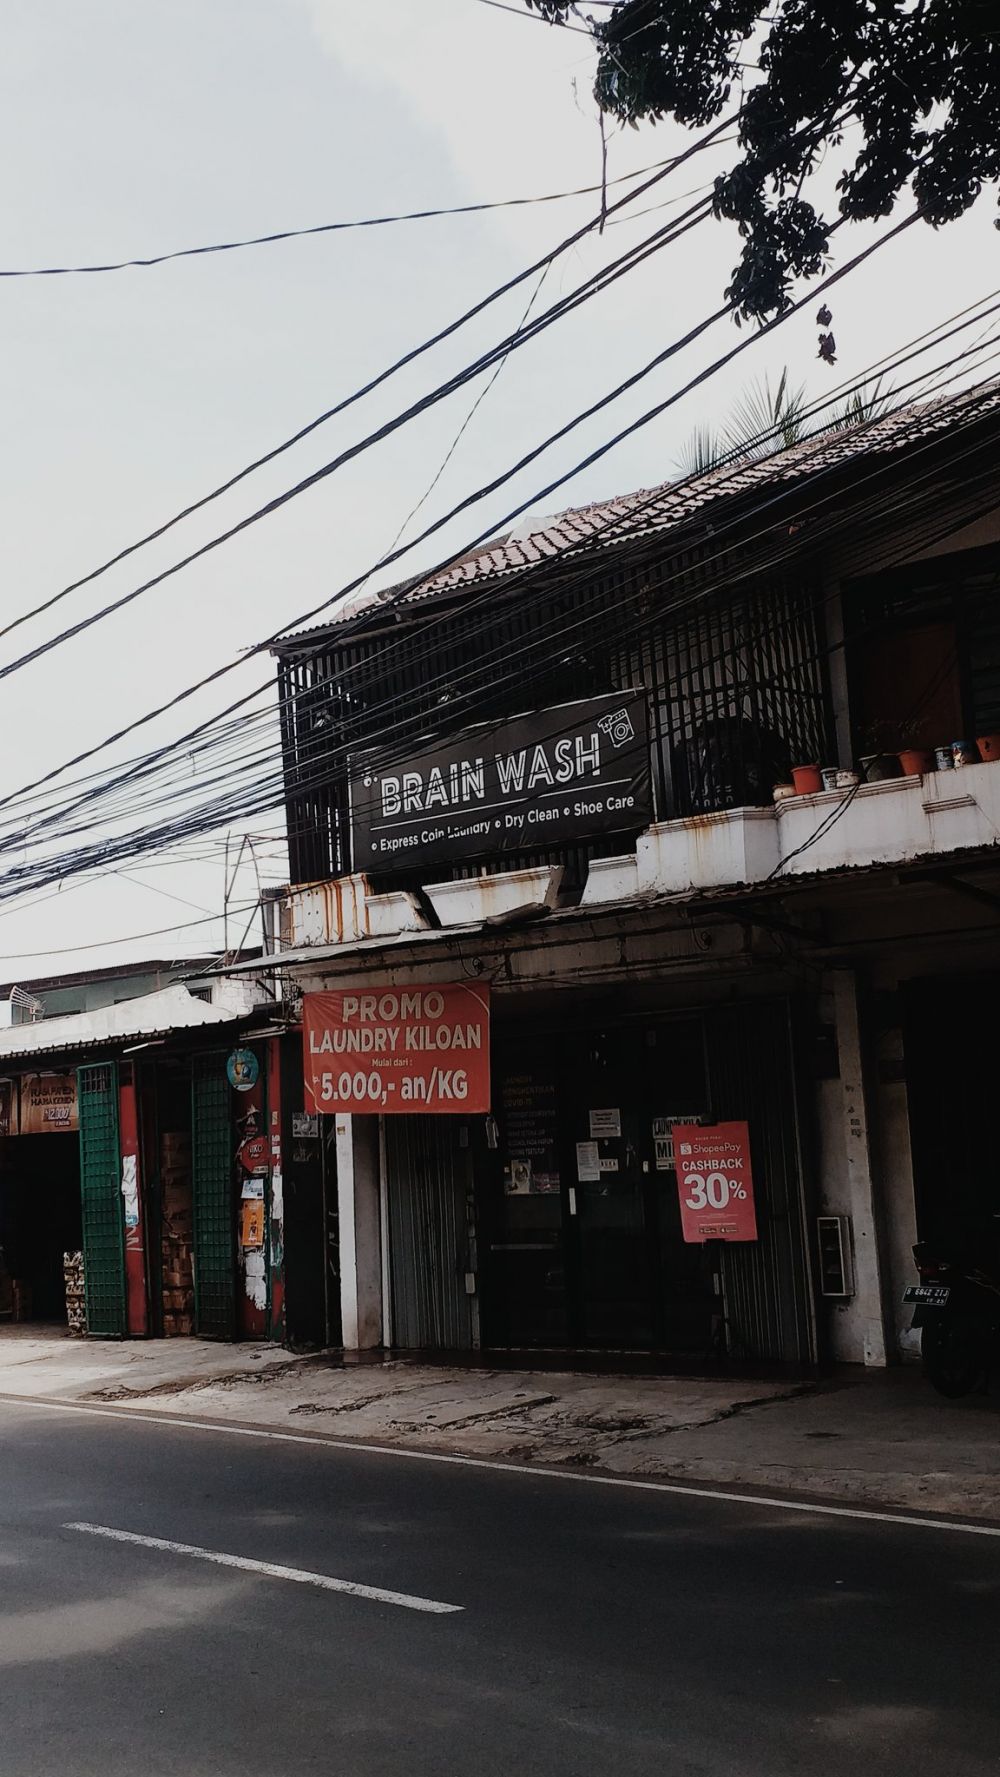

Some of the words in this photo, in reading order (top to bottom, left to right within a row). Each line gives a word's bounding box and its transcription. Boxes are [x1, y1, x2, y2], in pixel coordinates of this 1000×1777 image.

[381, 757, 485, 817] BRAIN
[495, 733, 601, 794] WASH
[380, 835, 419, 852] Express
[421, 829, 445, 843] Coin
[505, 813, 525, 830] Dry
[527, 806, 560, 824] Clean
[574, 801, 603, 816] Shoe
[606, 795, 635, 810] Care
[342, 991, 444, 1023] PROMO
[309, 1026, 400, 1054] LAUNDRY
[405, 1023, 481, 1051] KILOAN
[371, 1058, 391, 1067] Mulai
[400, 1067, 468, 1104] an/KG
[682, 1158, 743, 1171] CASHBACK
[693, 1142, 742, 1155] ShopeePay
[684, 1172, 747, 1210] 30%
